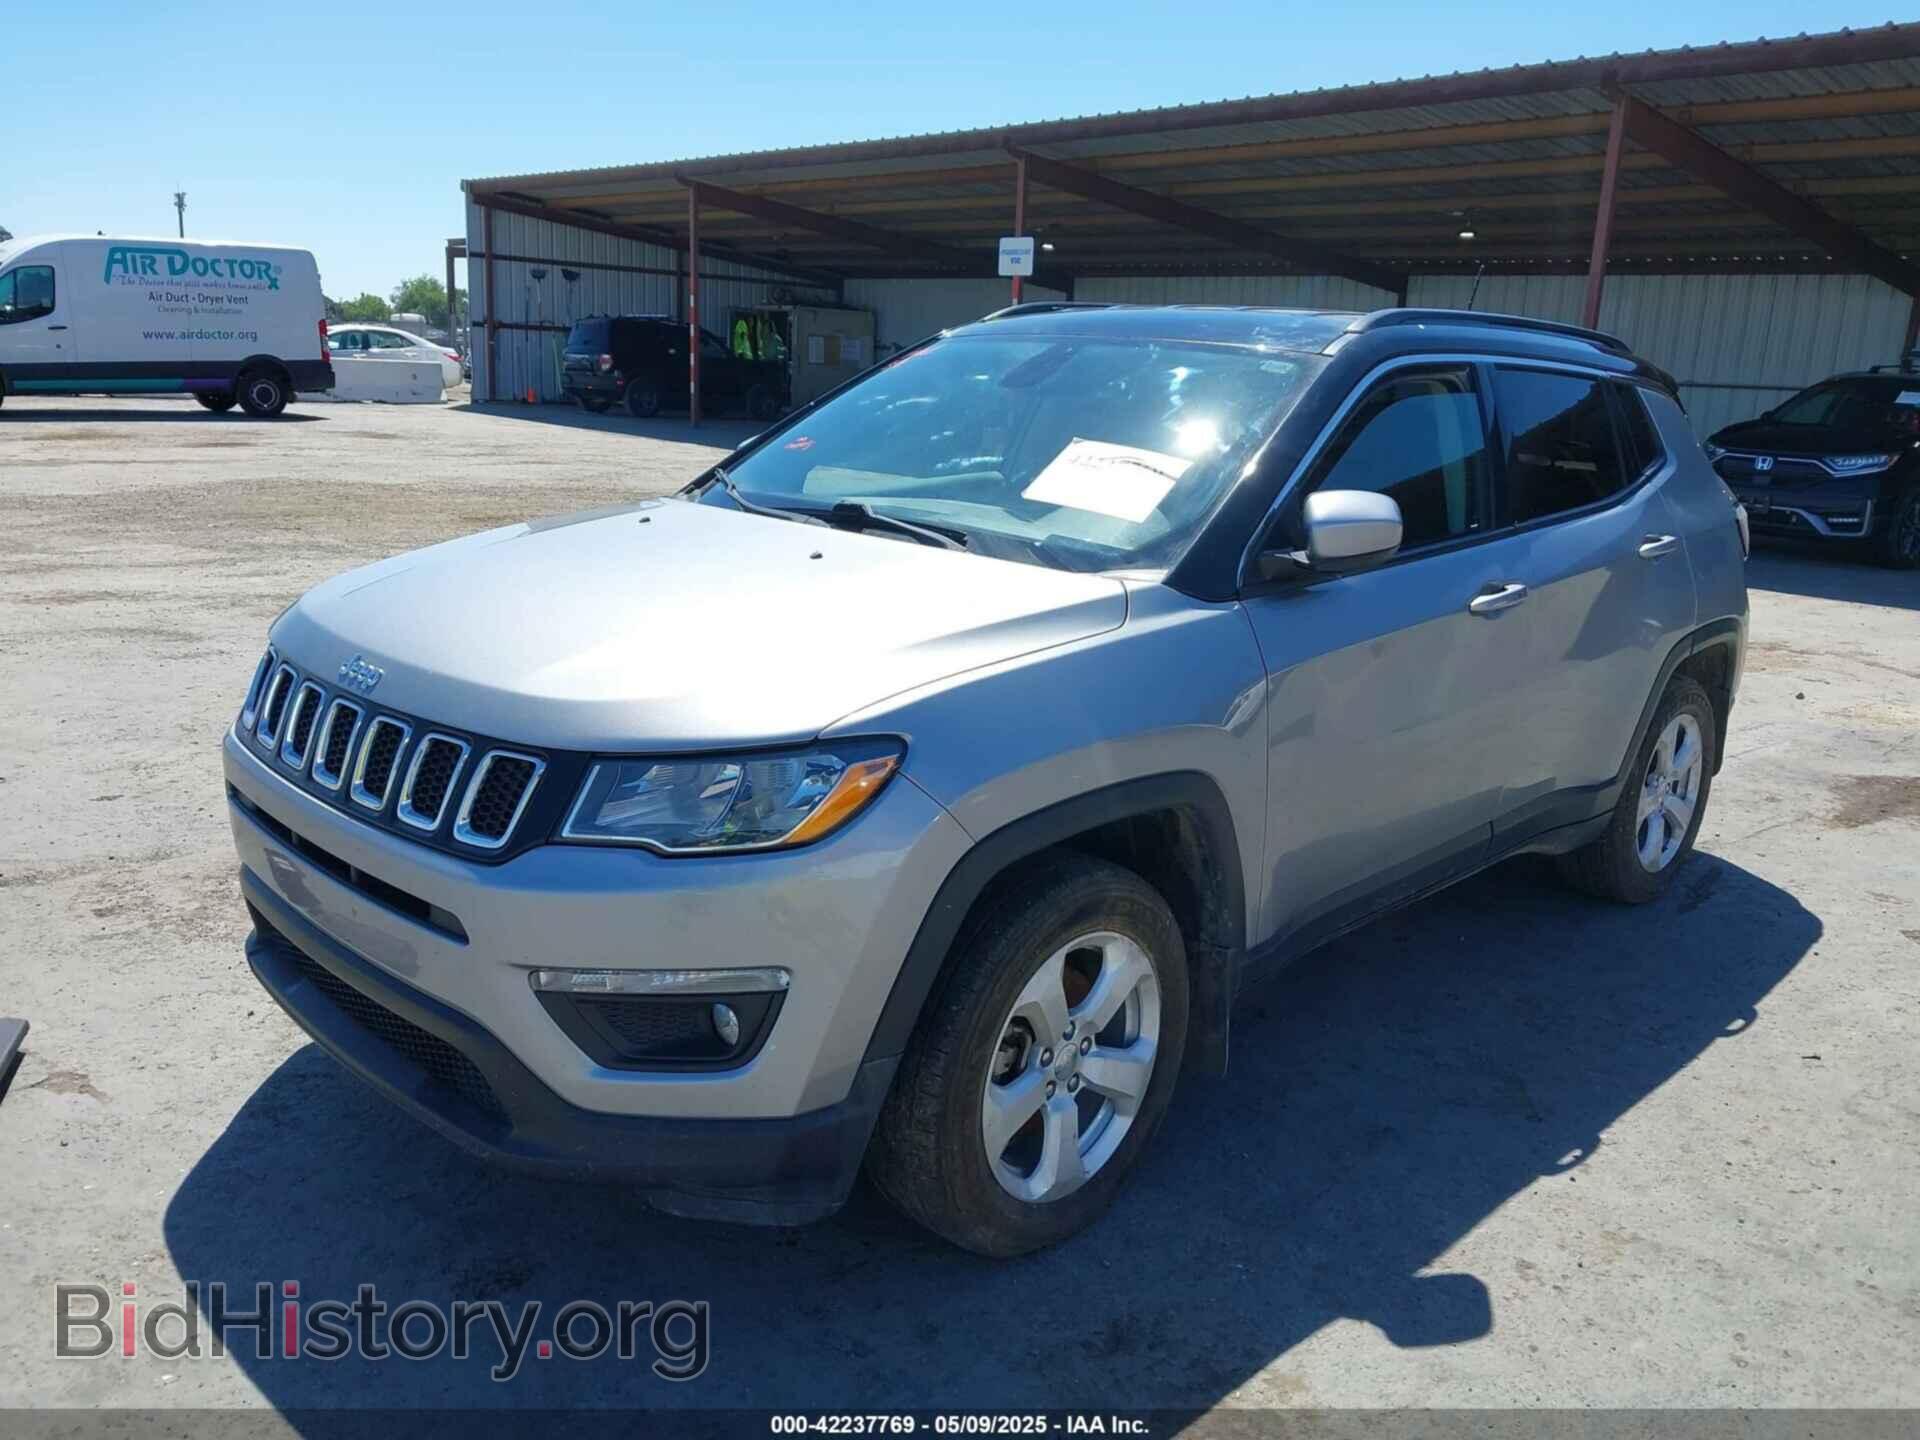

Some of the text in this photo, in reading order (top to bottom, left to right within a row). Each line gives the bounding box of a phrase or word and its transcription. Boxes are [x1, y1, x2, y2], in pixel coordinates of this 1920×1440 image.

[104, 247, 160, 284] AIR
[148, 291, 163, 302] Air
[166, 292, 189, 303] Duct
[197, 293, 223, 305] Dryer
[225, 294, 249, 304] Vent
[143, 328, 258, 343] www.airdoctor.org
[339, 654, 385, 689] Jeep
